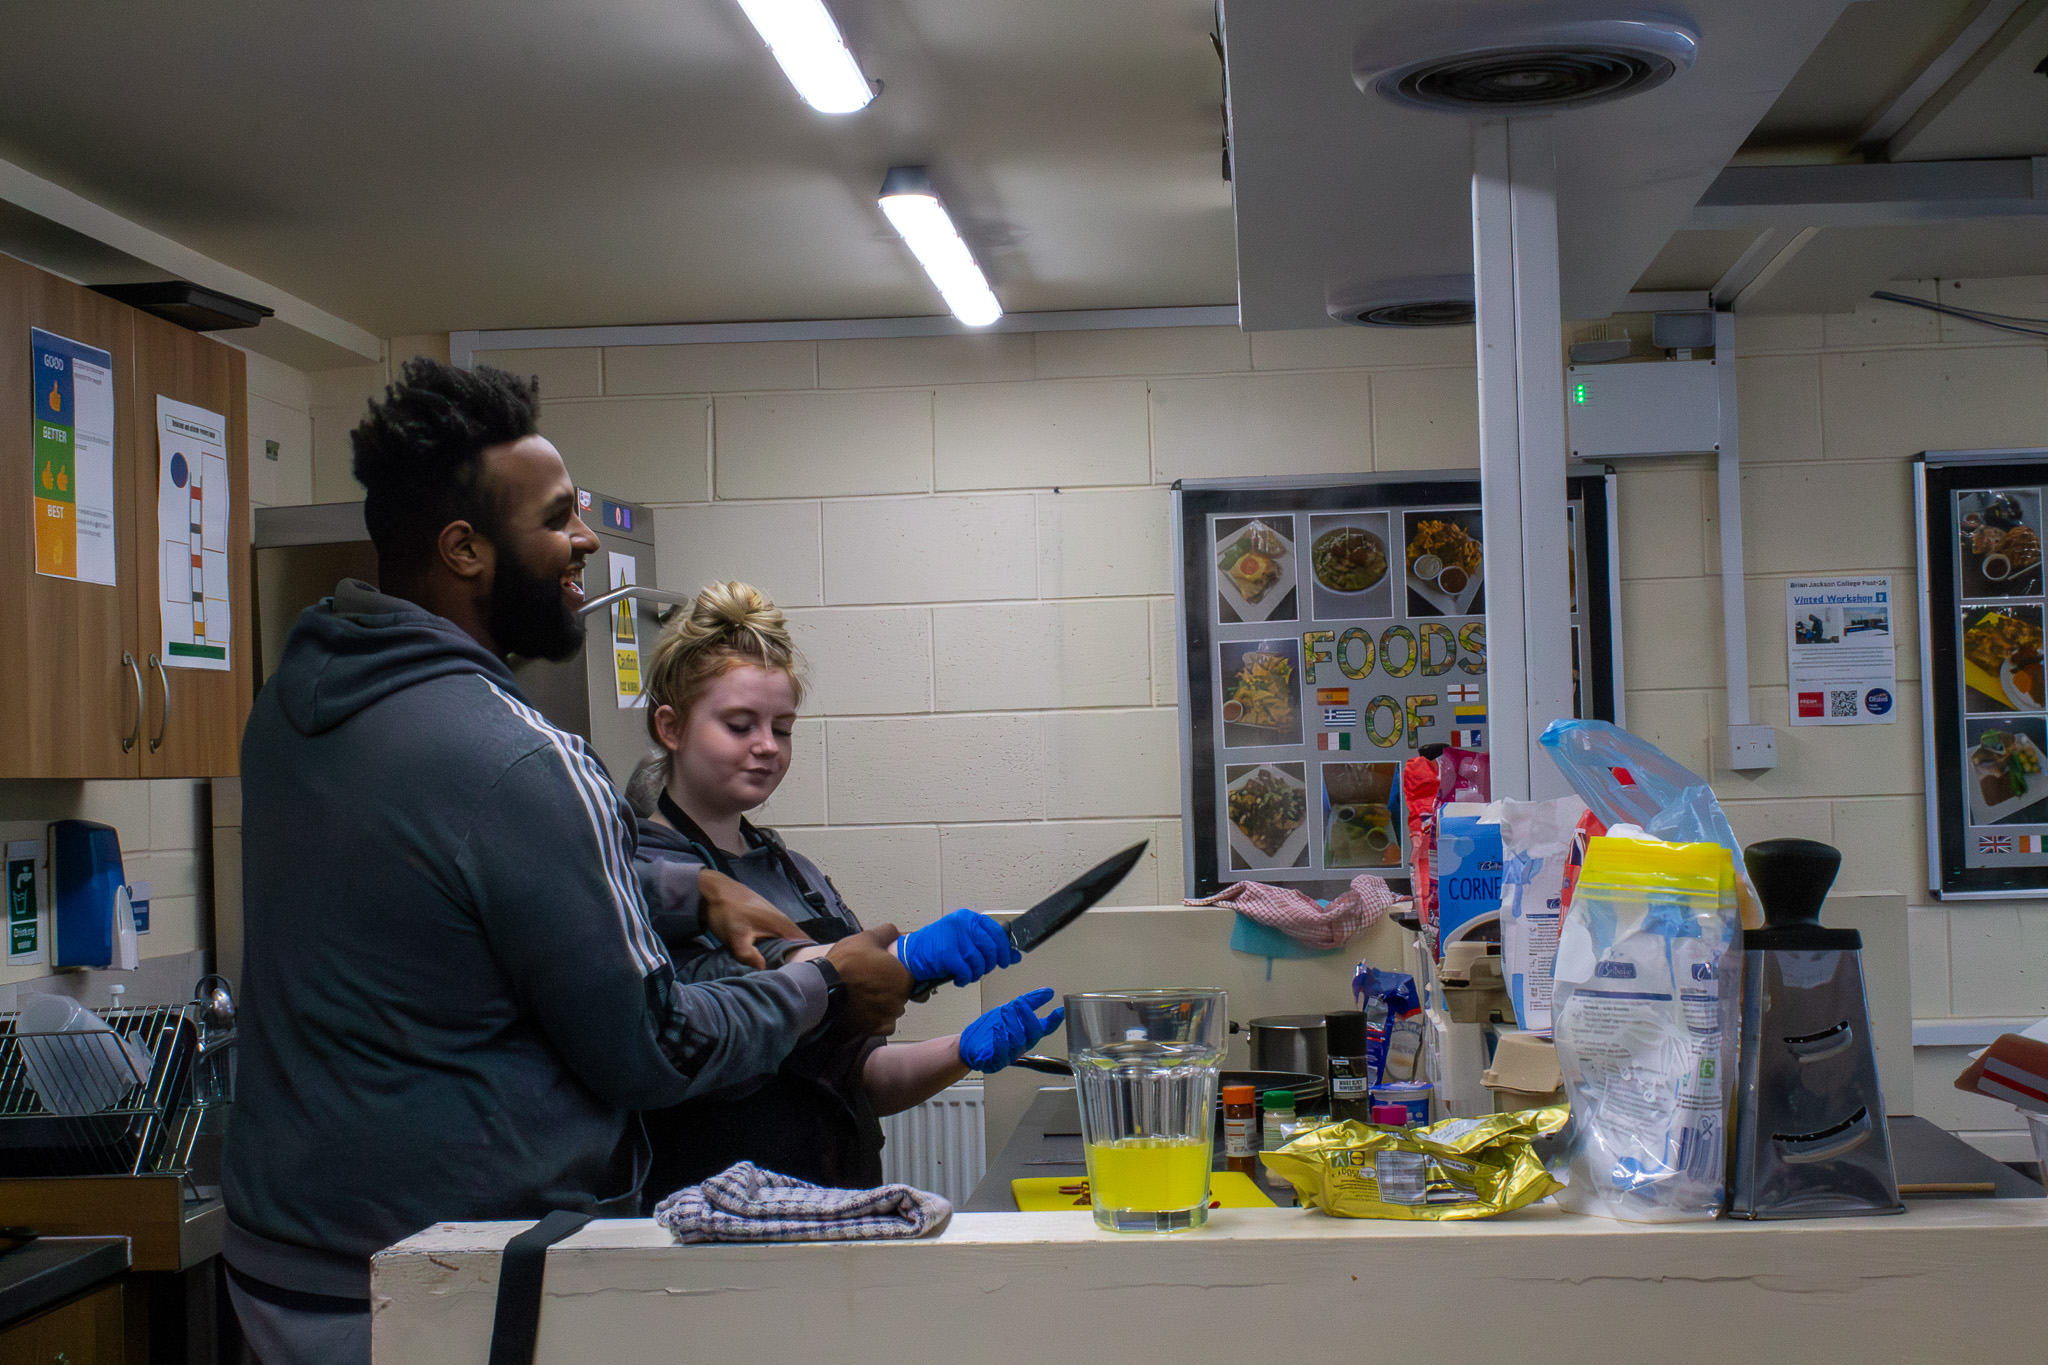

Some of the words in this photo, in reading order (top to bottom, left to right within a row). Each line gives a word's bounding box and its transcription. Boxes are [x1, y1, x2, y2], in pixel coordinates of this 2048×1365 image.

[43, 353, 64, 371] GOOD
[43, 425, 67, 443] BETTER
[47, 504, 64, 519] BEST
[1837, 580, 1860, 588] College
[1794, 594, 1824, 604] Vinted
[1827, 593, 1872, 604] Workshop
[1303, 622, 1487, 684] FOODS
[1365, 694, 1438, 749] OF
